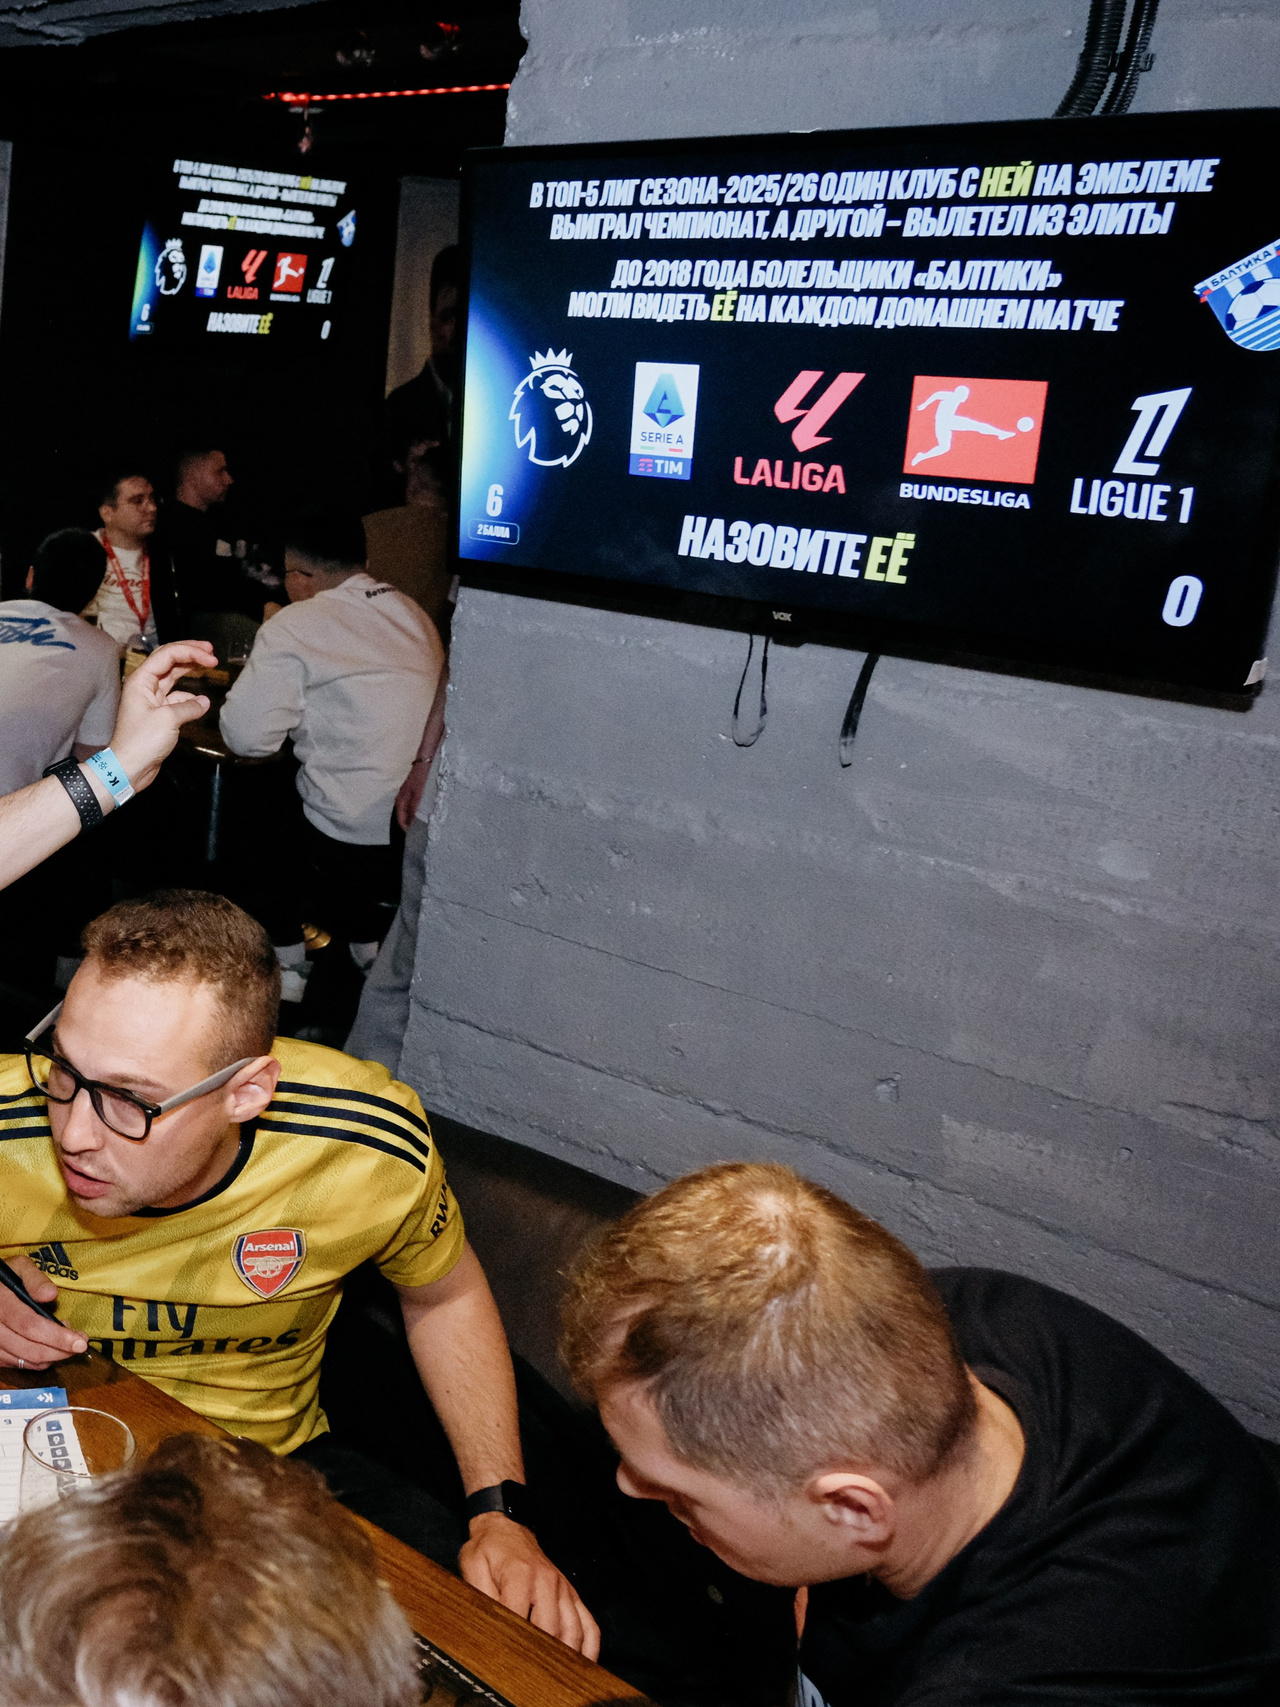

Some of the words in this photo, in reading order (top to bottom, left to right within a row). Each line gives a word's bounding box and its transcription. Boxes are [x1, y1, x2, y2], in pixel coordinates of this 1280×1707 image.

[529, 182, 544, 208] В
[546, 180, 600, 207] ТОП-5
[599, 178, 640, 206] ЛИГ
[639, 173, 819, 206] СЕЗОНА-2025/26
[819, 171, 887, 204] ОДИН
[887, 168, 958, 200] КЛУБ
[958, 168, 980, 198] С
[978, 161, 1035, 198] НЕЙ
[1032, 164, 1073, 197] НА
[1075, 158, 1220, 196] ЭМБЛЕМЕ
[550, 213, 644, 240] ВЫИГРАЛ
[644, 210, 770, 240] ЧЕМПИОНАТ,
[771, 210, 789, 238] А
[789, 203, 886, 241] ДРУГОЙ
[902, 205, 1026, 237] ВЫЛЕТЕЛ
[1025, 204, 1066, 236] ИЗ
[1066, 202, 1175, 236] ЭЛИТЫ
[611, 259, 643, 289] ДО
[642, 259, 693, 287] 2018
[691, 260, 749, 291] ГОДА
[749, 260, 915, 292] БОЛЕЛЬЩИКИ
[914, 260, 1062, 291] «БАЛТИКИ»
[1210, 250, 1272, 287] БАЛТИКА
[568, 292, 633, 318] МОГЛИ
[631, 293, 711, 322] ВИДЕТЬ
[710, 291, 738, 321] ЕЁ
[735, 294, 767, 323] НА
[768, 295, 878, 327] КАЖДОМ
[874, 297, 1029, 330] ДОМАШНЕМ
[1029, 299, 1125, 331] МАТЧЕ
[641, 431, 673, 444] SERIE
[675, 435, 684, 445] A
[655, 459, 683, 476] TIM
[733, 456, 847, 494] LALIGA
[486, 483, 504, 517] 6
[899, 482, 1031, 510] BUNDESLIGA
[1069, 477, 1171, 523] LIGUE
[1178, 487, 1194, 524] 1
[476, 523, 484, 535] 2
[677, 515, 867, 579] НАЗОВИТЕ
[864, 532, 916, 585] ЕЁ
[1161, 575, 1204, 628] 0
[430, 1183, 449, 1238] RW
[244, 1240, 295, 1253] Arsenal
[36, 1392, 54, 1403] K+
